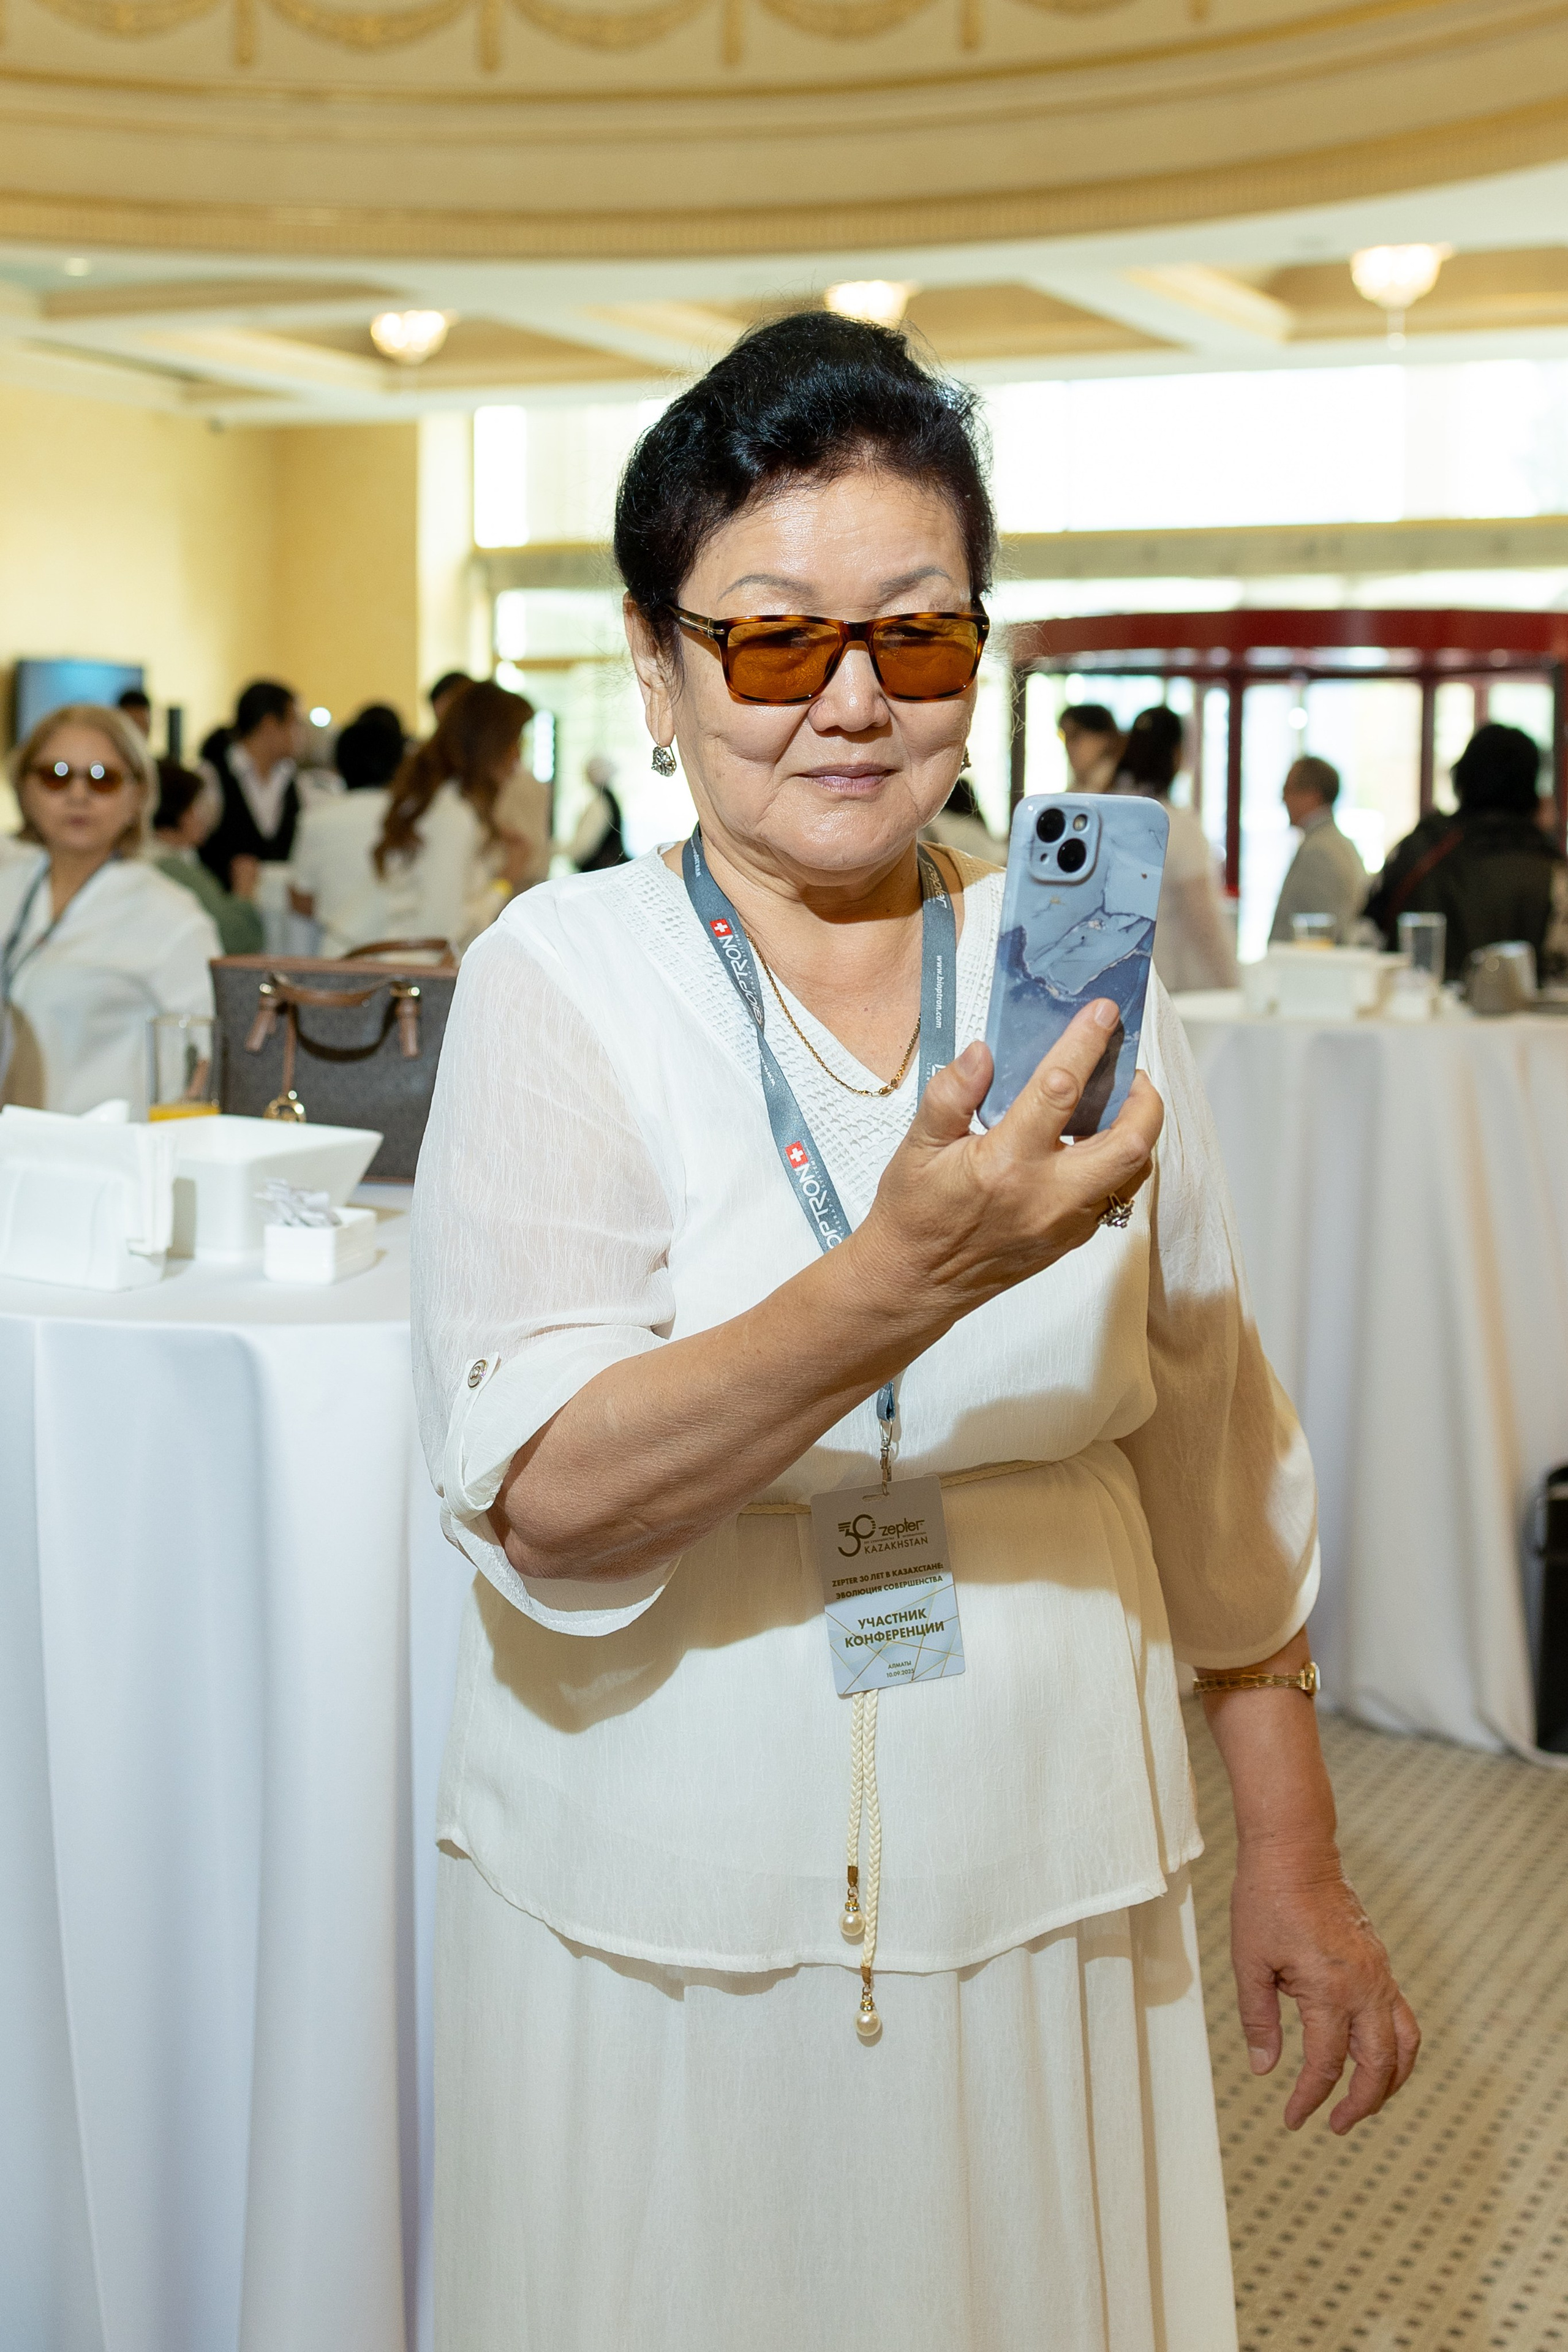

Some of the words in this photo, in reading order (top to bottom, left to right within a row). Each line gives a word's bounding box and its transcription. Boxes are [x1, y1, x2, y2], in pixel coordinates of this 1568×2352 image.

[935, 955, 944, 1028] www.bioptron.com
[810, 1160, 826, 1188] SYSTEM
[878, 1518, 925, 1539] zepter
[864, 1536, 928, 1555] KAZAKHSTAN
[832, 1577, 858, 1587] ZEPTER
[892, 1562, 944, 1577] КАЗАХСТАНЕ:
[836, 1585, 882, 1599] ЭВОЛЮЦИЯ
[884, 1575, 943, 1591] СОВЕРШЕНСТВА
[858, 1608, 927, 1629] УЧАСТНИК
[845, 1621, 944, 1648] КОНФЕРЕНЦИИ
[886, 1668, 914, 1678] 10.09.2025
[888, 1660, 911, 1670] АЛМАТЫ
